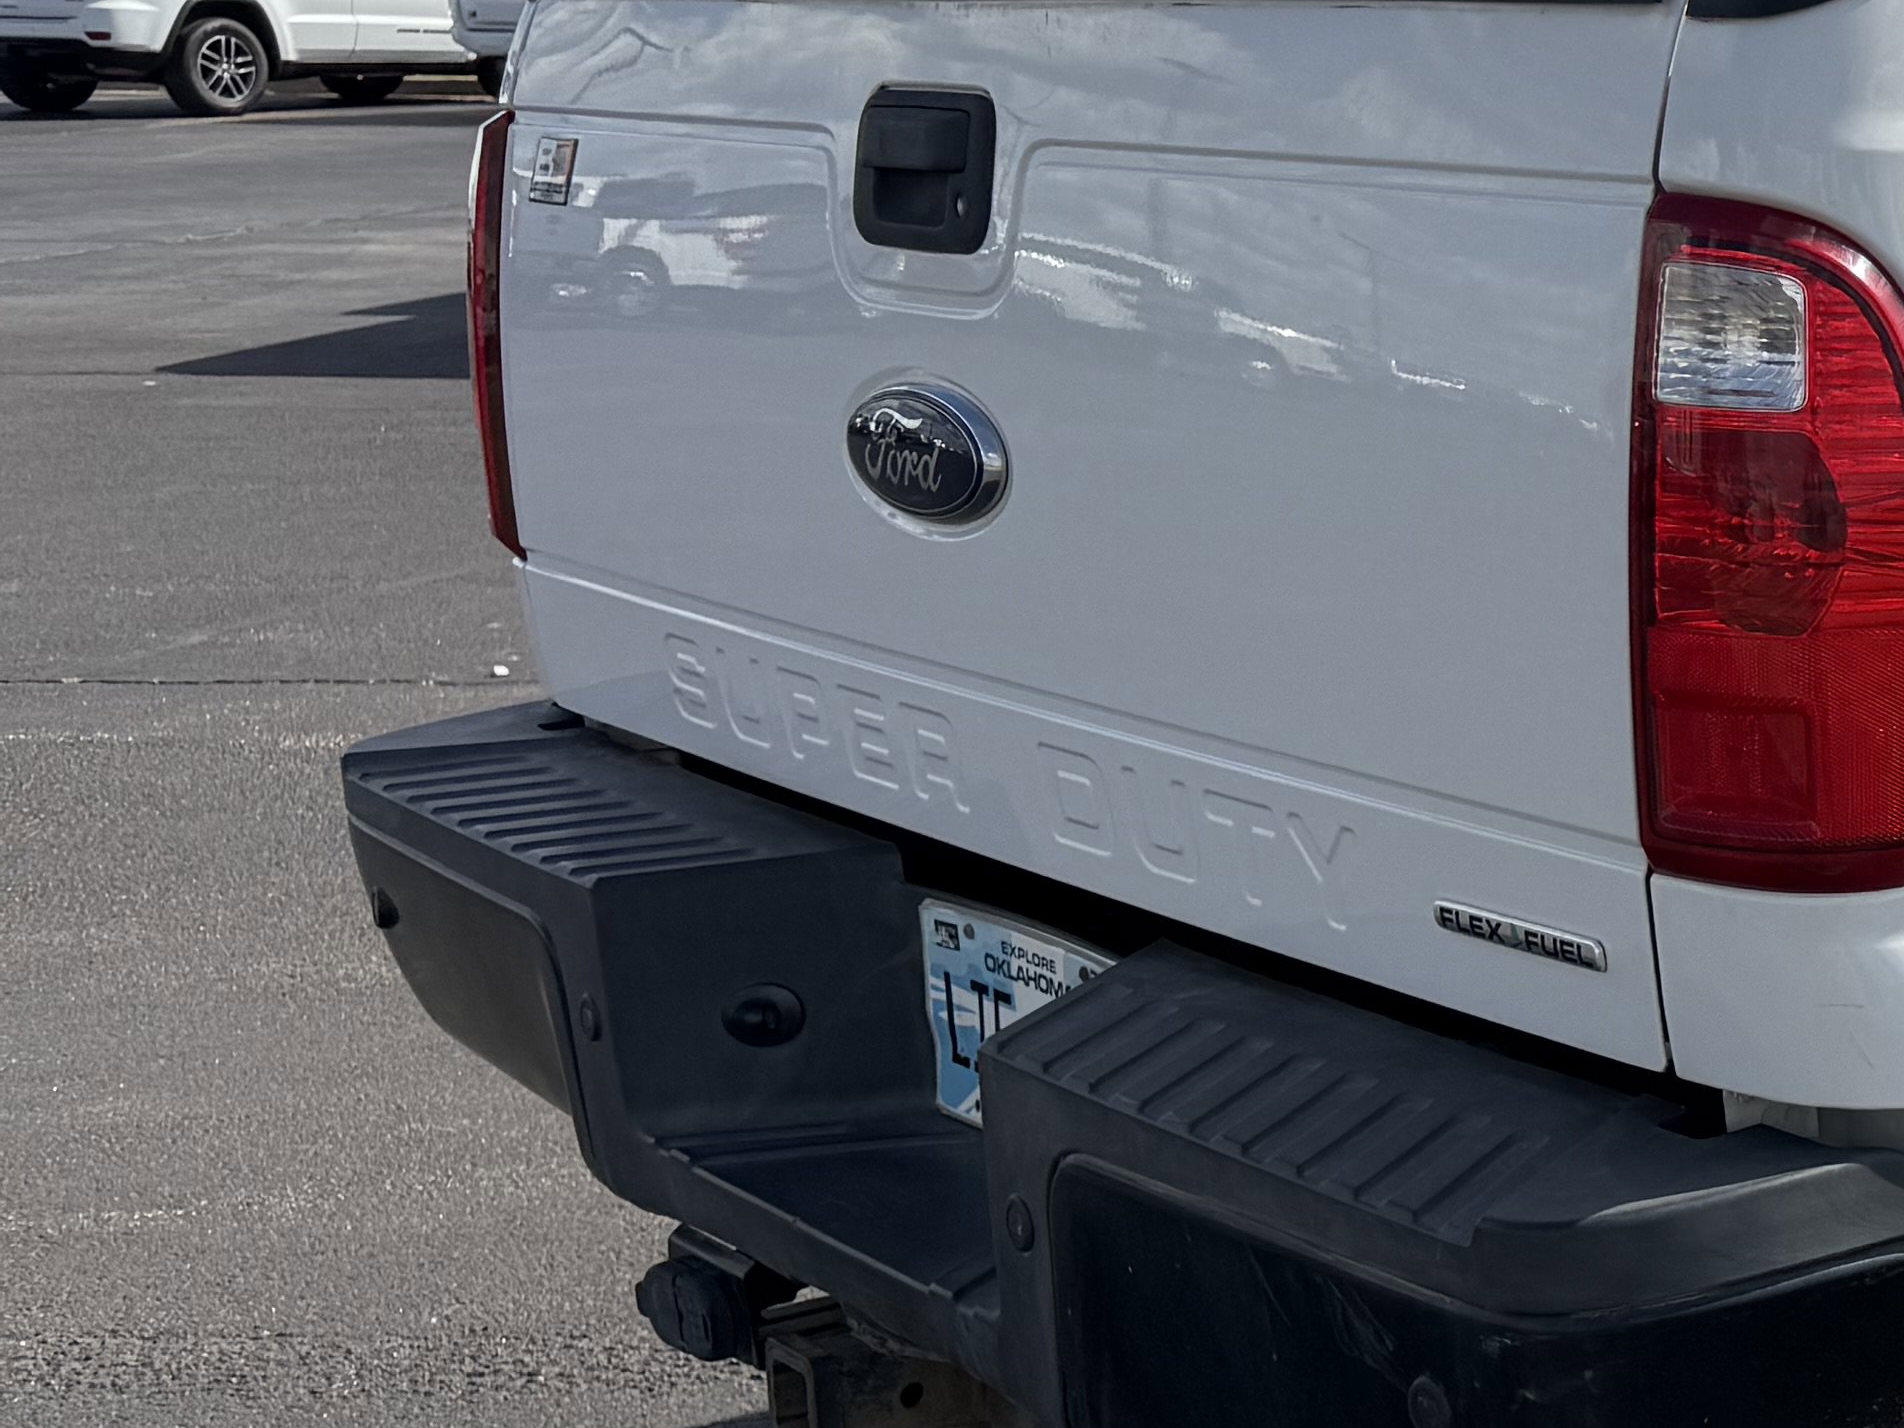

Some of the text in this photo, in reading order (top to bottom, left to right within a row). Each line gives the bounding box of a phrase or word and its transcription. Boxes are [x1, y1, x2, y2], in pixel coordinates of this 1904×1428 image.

[865, 408, 941, 492] Ford
[664, 632, 1357, 932] SUPER DUTY
[1001, 940, 1057, 975] EXPLORE
[1439, 906, 1596, 969] FLEX FUEL
